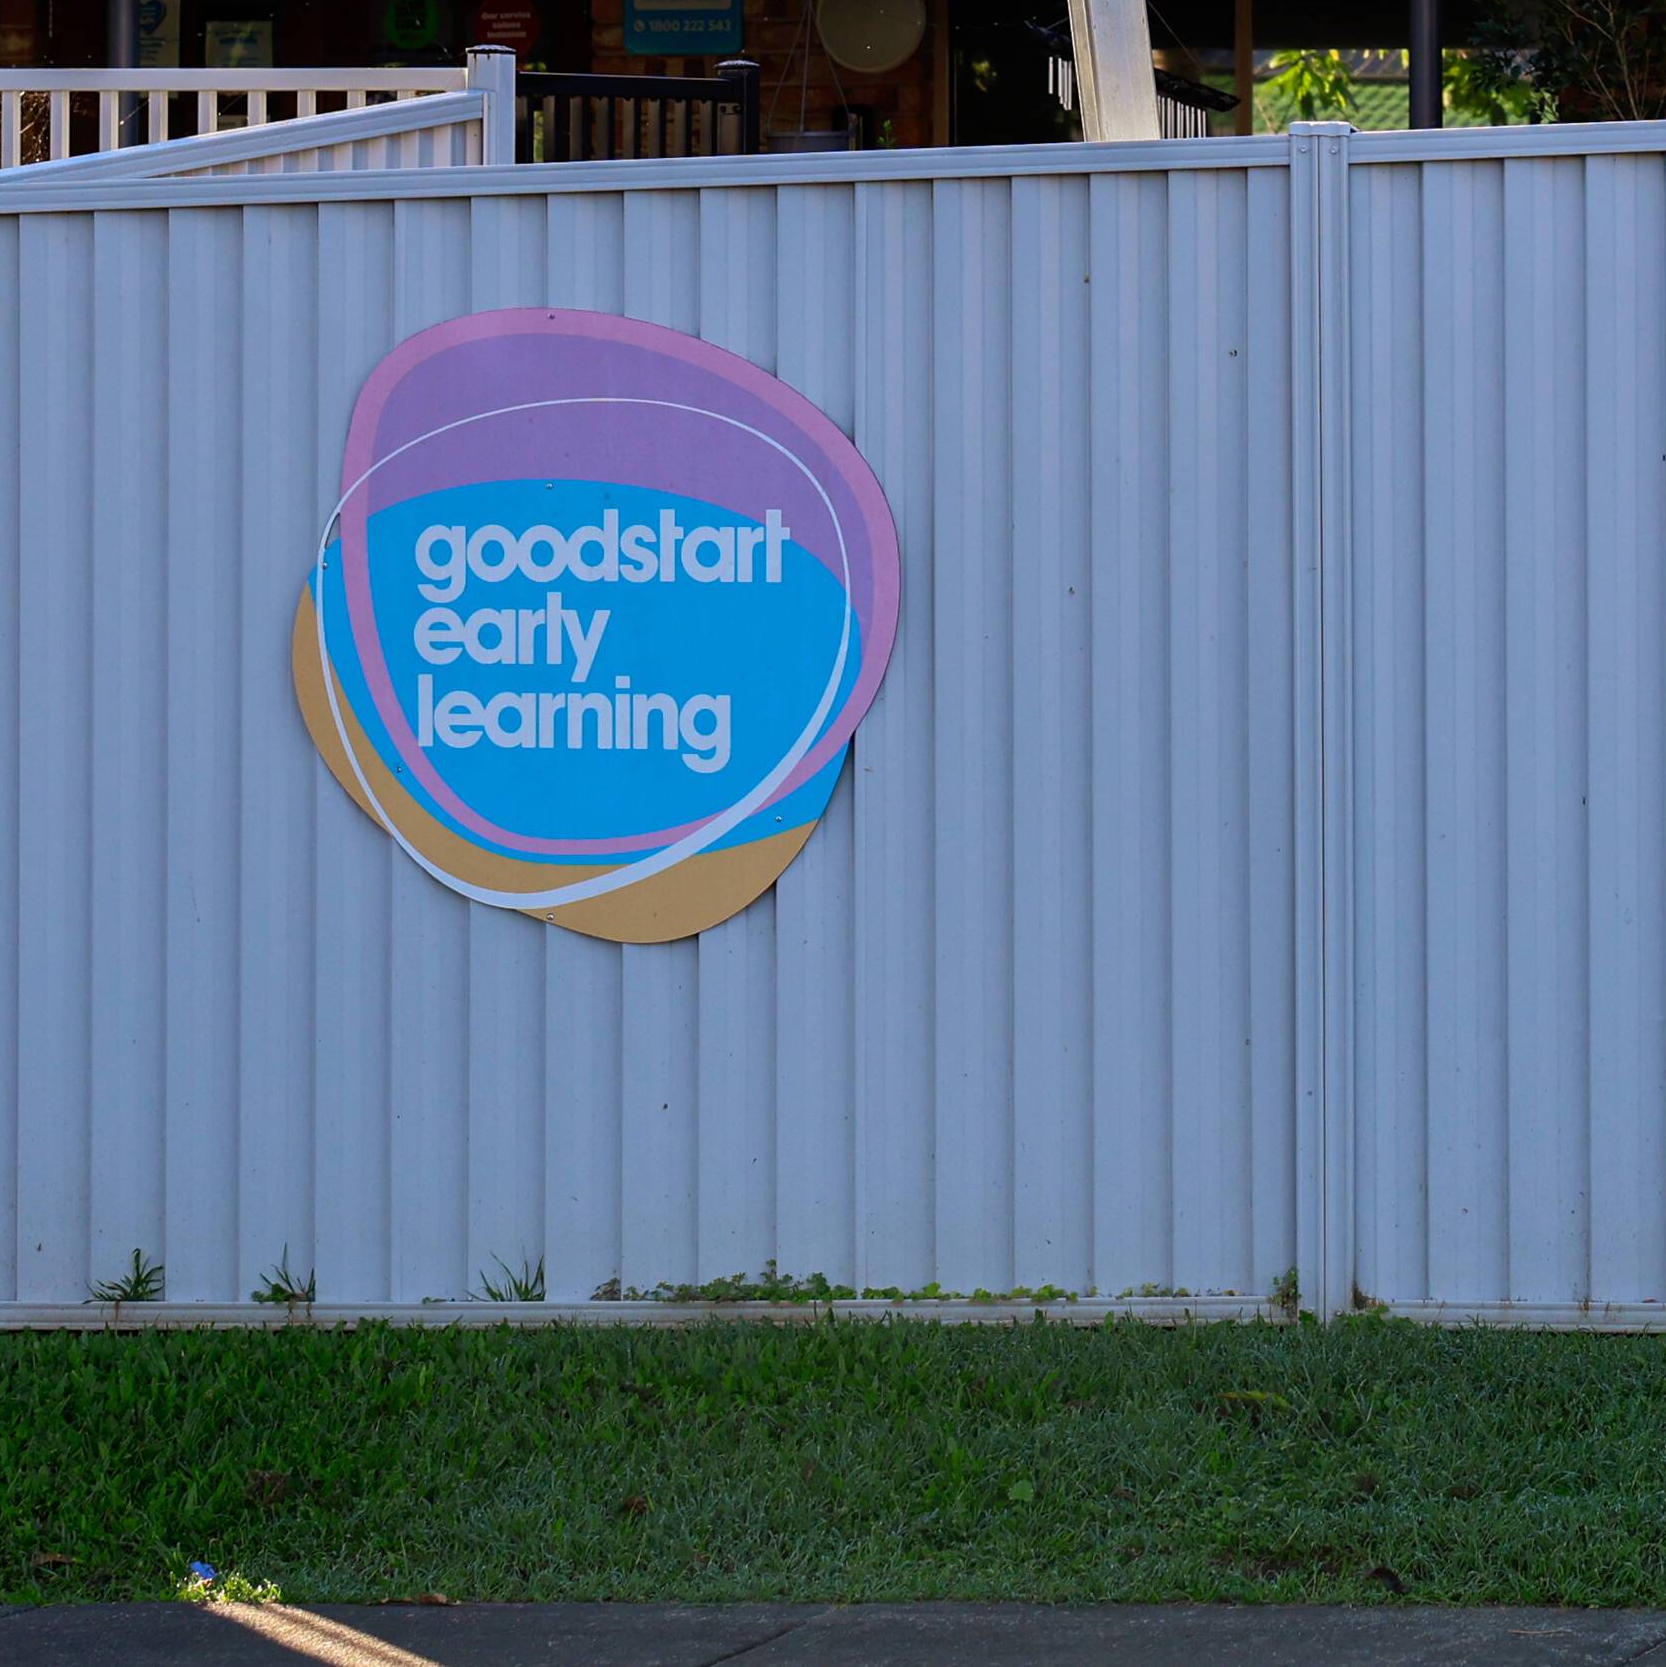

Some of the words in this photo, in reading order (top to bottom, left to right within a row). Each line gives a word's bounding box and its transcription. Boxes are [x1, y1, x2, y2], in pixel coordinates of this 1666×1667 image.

[648, 19, 680, 31] 1800
[683, 19, 705, 31] 222
[414, 508, 791, 604] goodstart
[413, 591, 611, 684] early
[417, 673, 733, 775] learning
